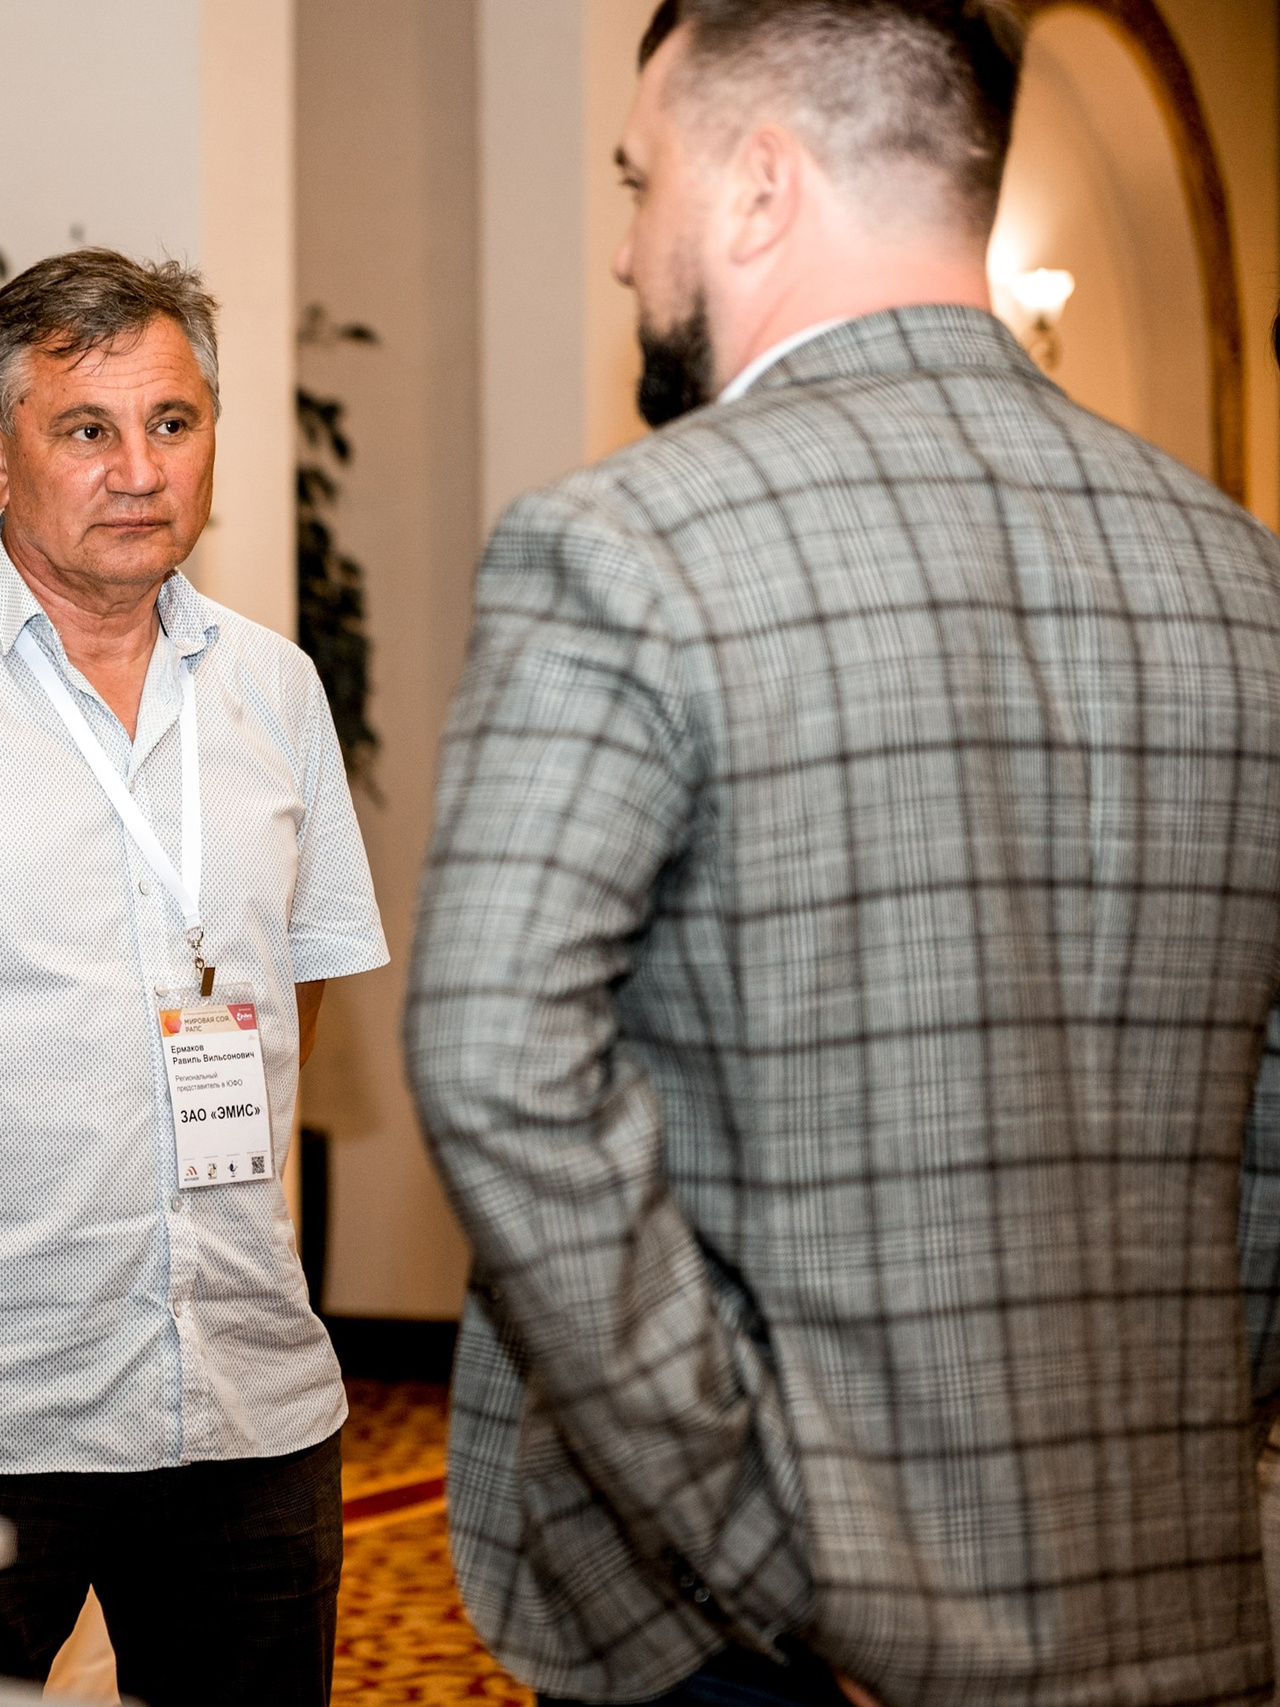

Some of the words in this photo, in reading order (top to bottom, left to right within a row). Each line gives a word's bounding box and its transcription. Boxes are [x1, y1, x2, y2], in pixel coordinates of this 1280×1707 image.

[184, 1016, 214, 1025] МИРОВАЯ
[171, 1045, 204, 1054] Ермаков
[172, 1056, 201, 1065] Равиль
[203, 1051, 255, 1062] Вильсонович
[175, 1072, 218, 1082] Региональный
[177, 1082, 220, 1092] представитель
[226, 1079, 243, 1087] ЮФО
[180, 1108, 207, 1123] ЗАО
[210, 1103, 261, 1119] «ЭМИС»
